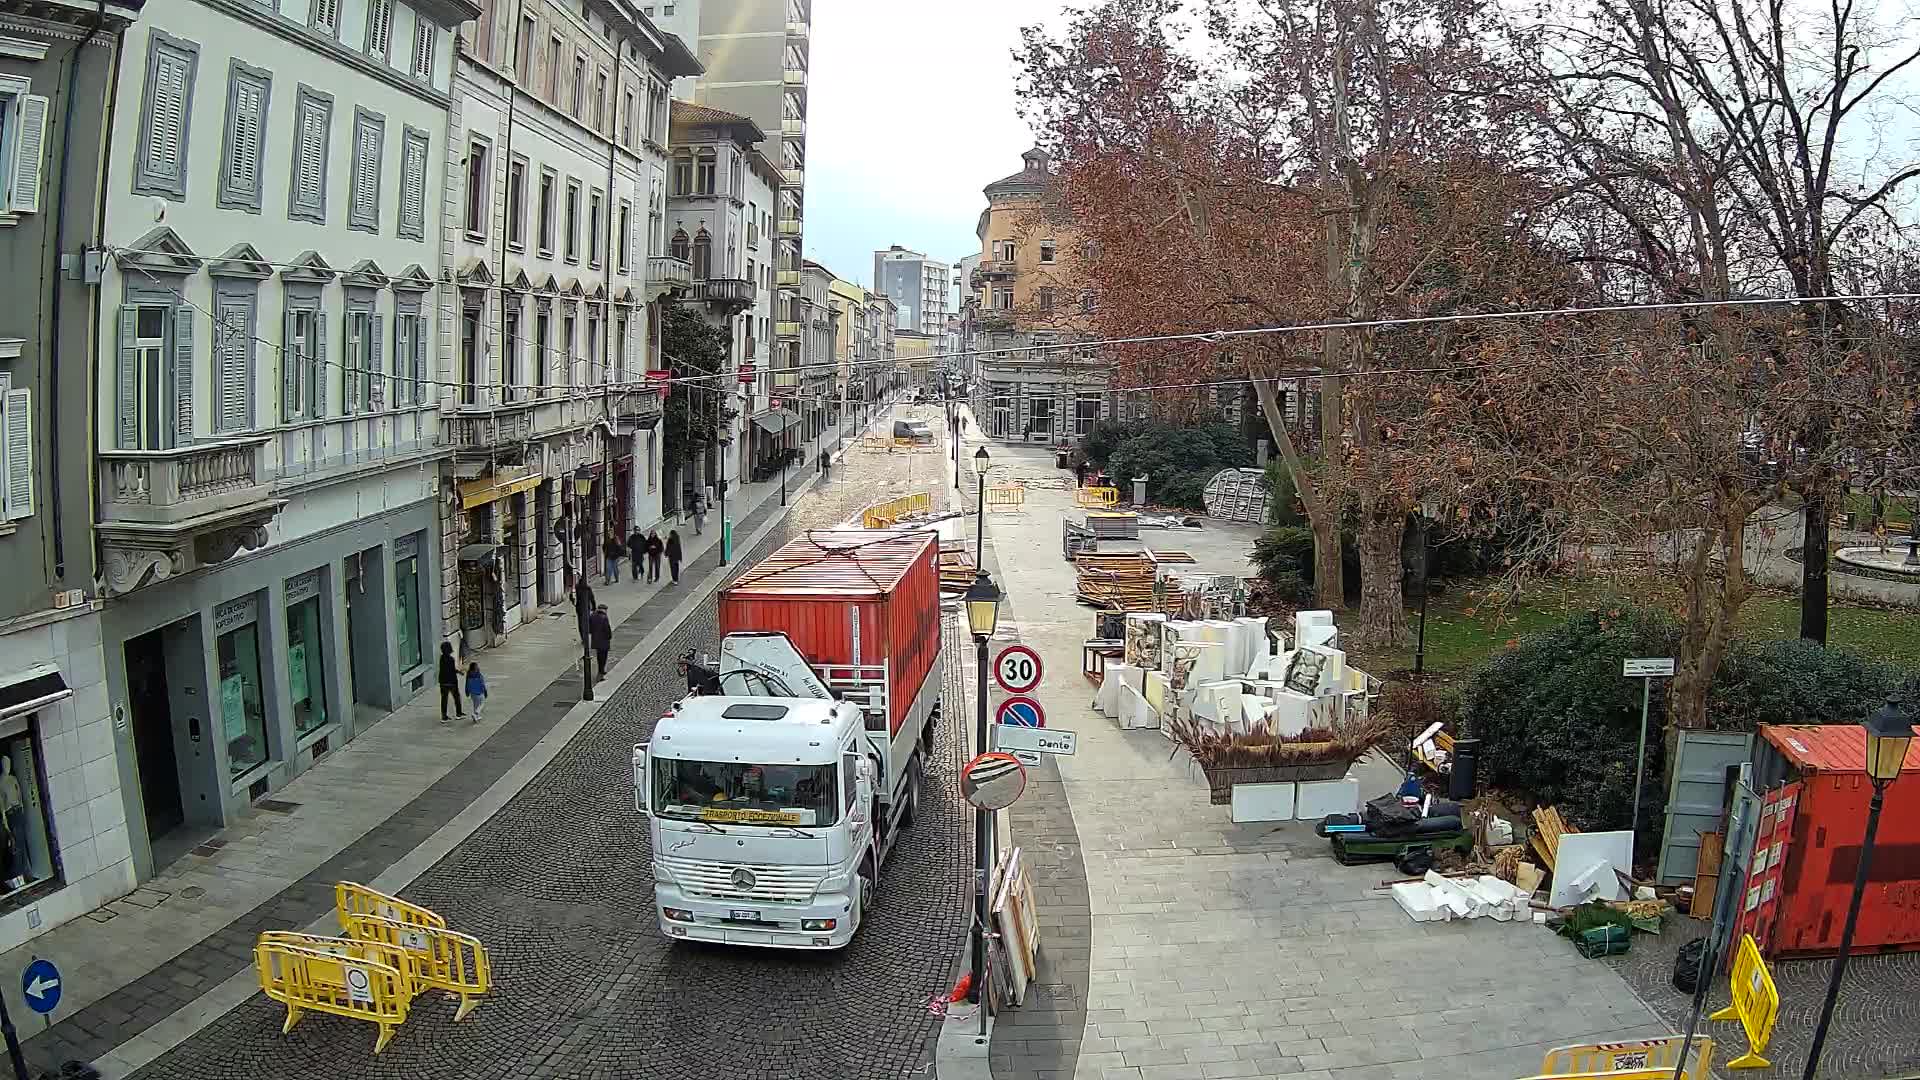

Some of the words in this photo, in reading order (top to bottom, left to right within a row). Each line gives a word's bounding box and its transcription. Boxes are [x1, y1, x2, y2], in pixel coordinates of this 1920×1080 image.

[1005, 659, 1032, 680] 30
[1039, 739, 1070, 750] Dante
[705, 809, 744, 821] TRASPORTO
